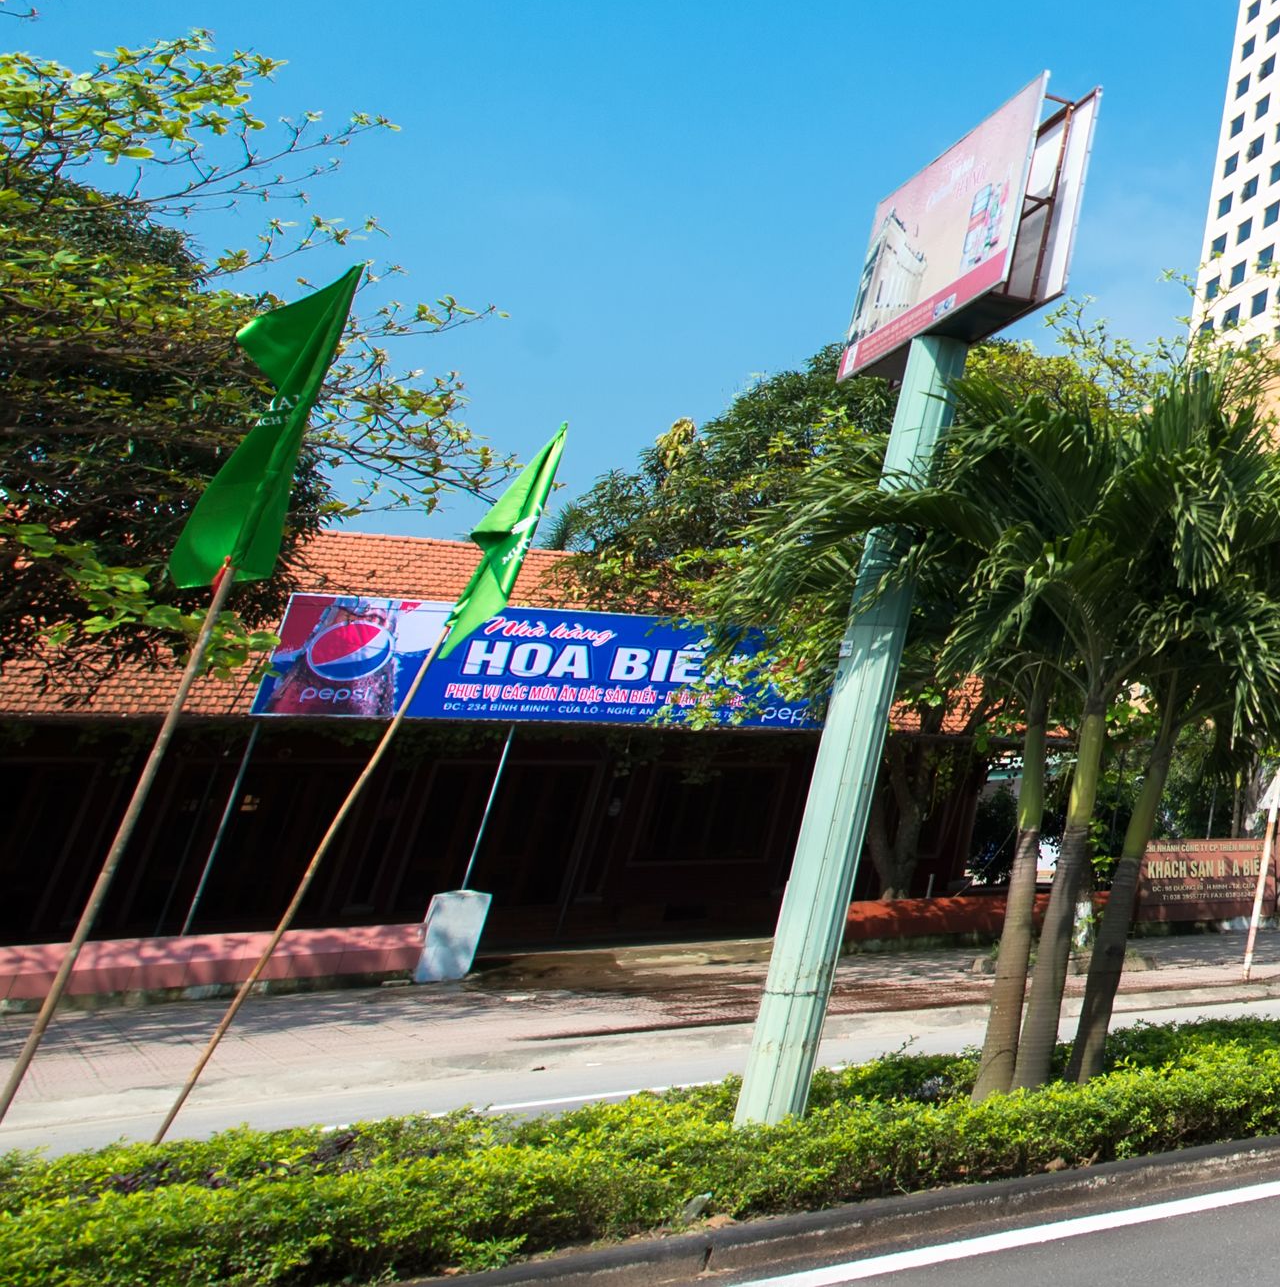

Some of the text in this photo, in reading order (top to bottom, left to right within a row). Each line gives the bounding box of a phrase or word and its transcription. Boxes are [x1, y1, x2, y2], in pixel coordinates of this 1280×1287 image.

[484, 616, 617, 647] Nhà hàng
[462, 640, 590, 679] HOA
[299, 686, 371, 704] pepsi
[445, 683, 482, 702] PHỤC
[483, 684, 501, 702] VỤ
[502, 683, 528, 700] CÁC
[528, 683, 558, 701] MÓN
[467, 703, 487, 712] 234
[520, 704, 549, 713] MINH
[1147, 856, 1187, 879] KHÁCH
[1190, 859, 1214, 881] SẠN
